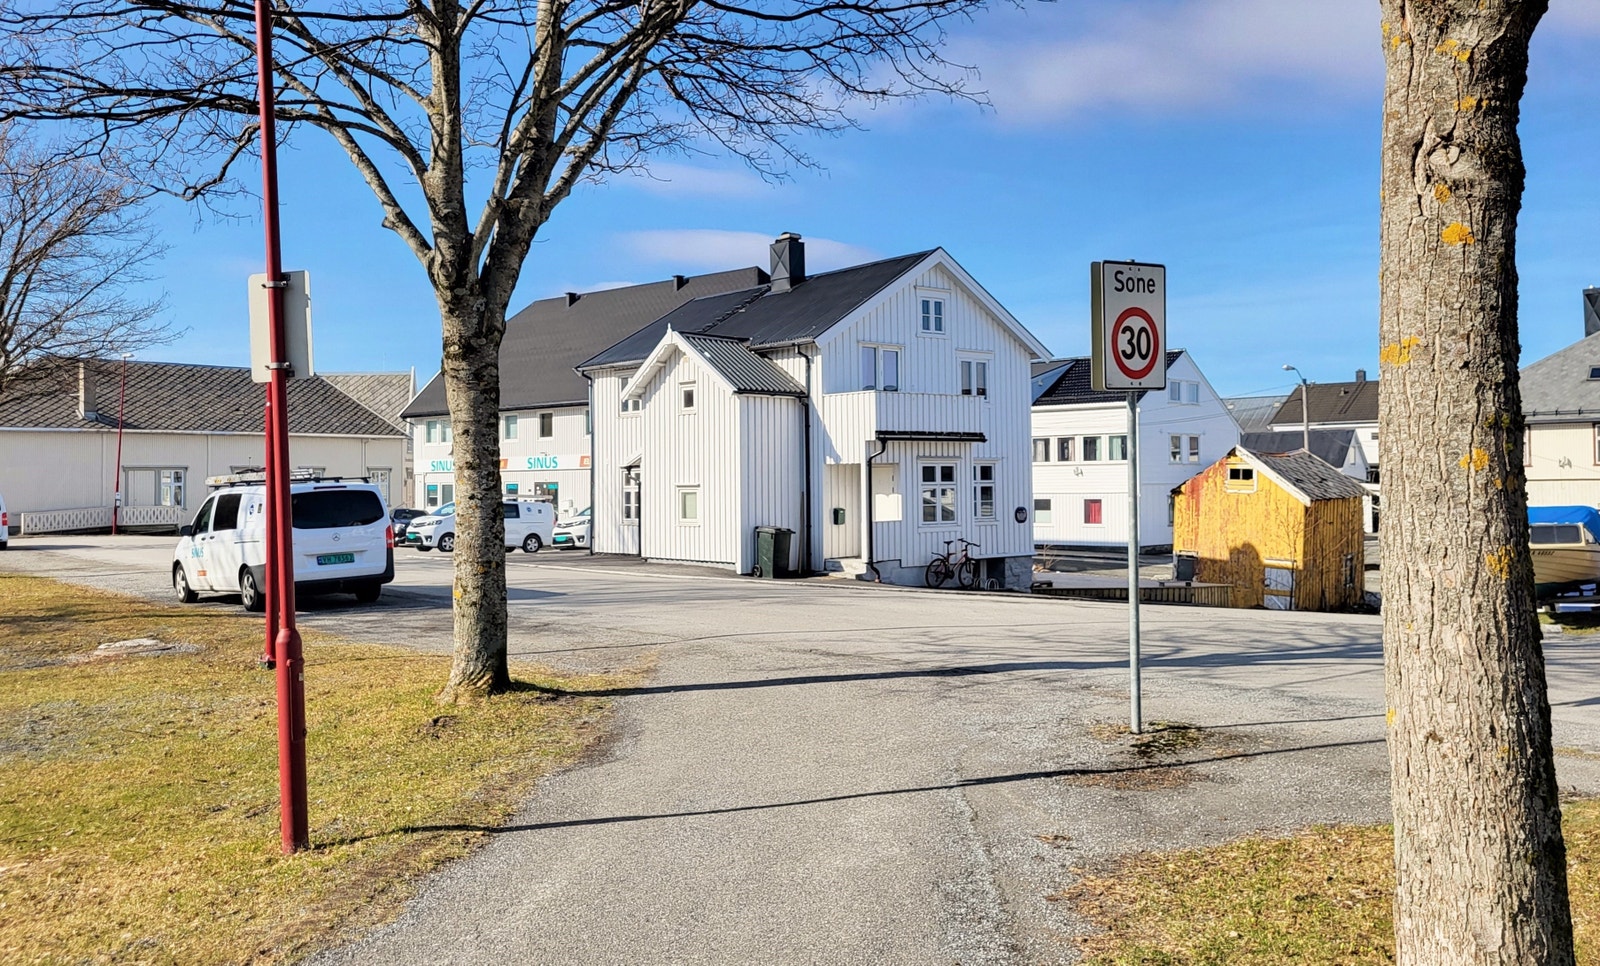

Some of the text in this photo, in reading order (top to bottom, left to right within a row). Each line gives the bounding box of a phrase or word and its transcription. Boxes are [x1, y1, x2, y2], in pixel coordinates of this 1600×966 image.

[1114, 270, 1155, 294] Sone
[1121, 325, 1151, 360] 30
[527, 456, 558, 469] SINUS
